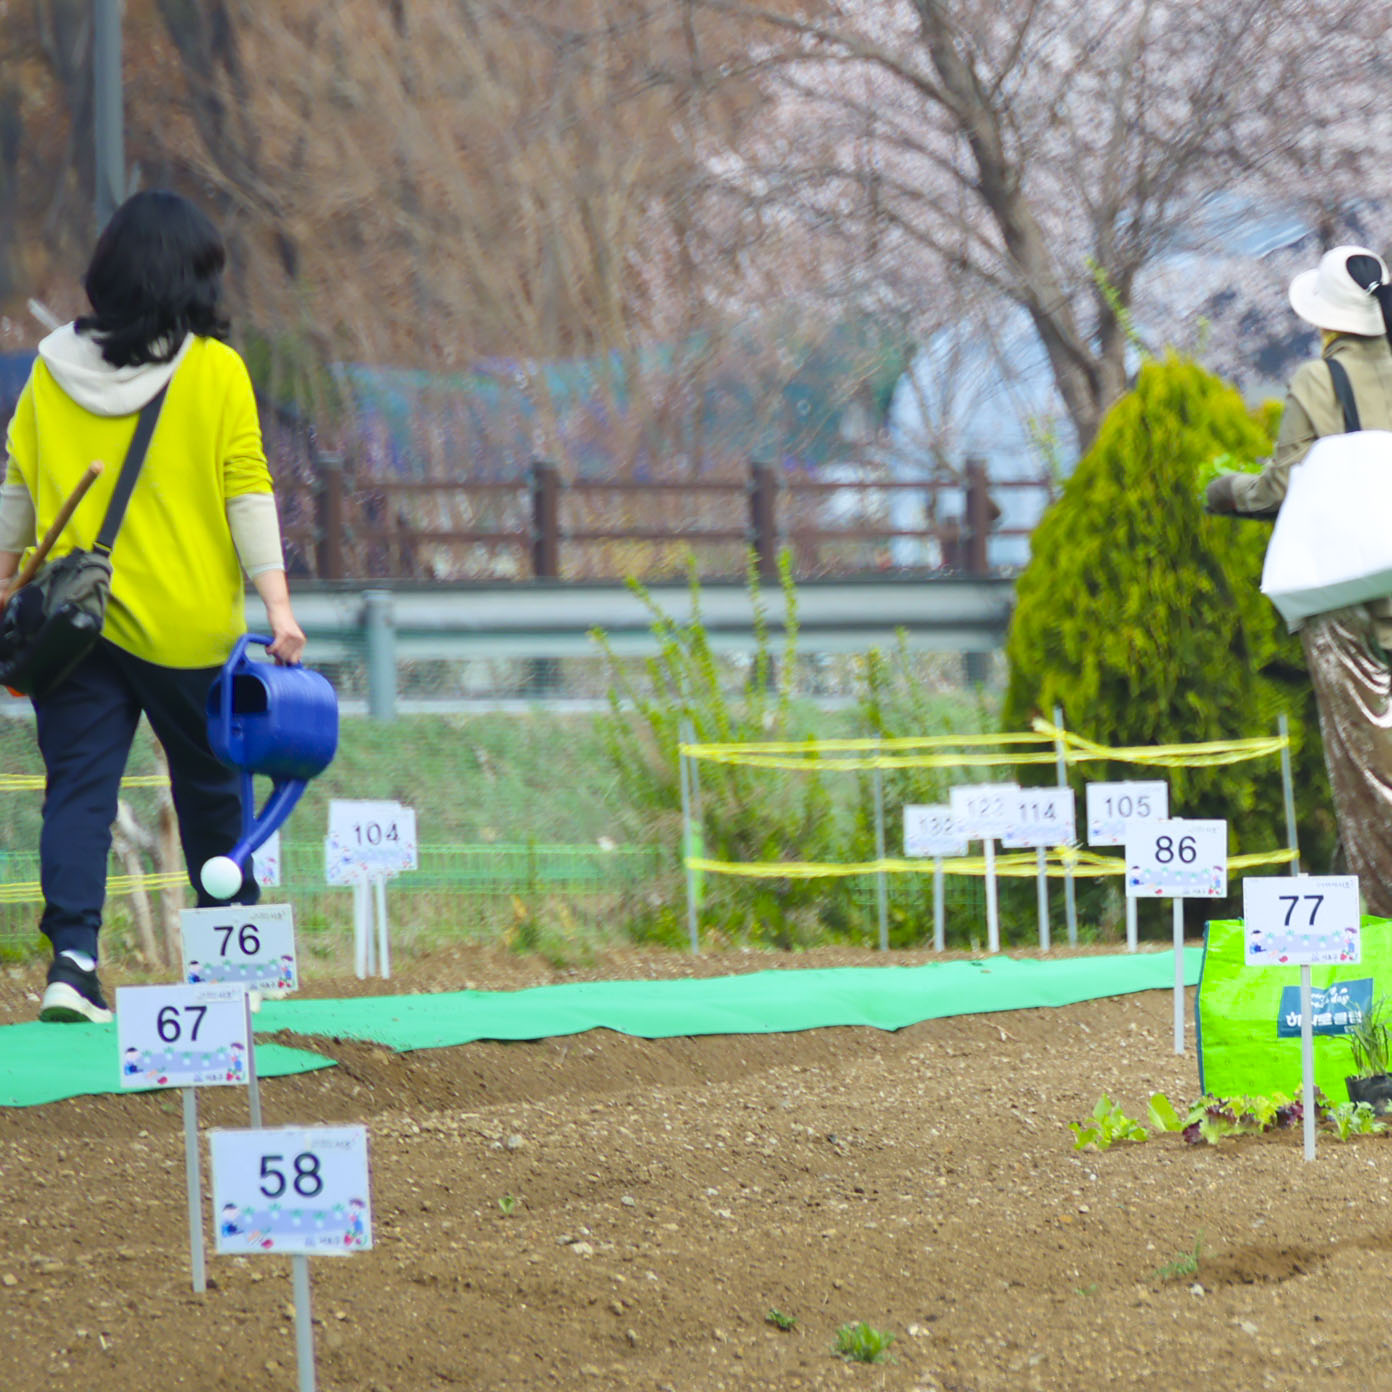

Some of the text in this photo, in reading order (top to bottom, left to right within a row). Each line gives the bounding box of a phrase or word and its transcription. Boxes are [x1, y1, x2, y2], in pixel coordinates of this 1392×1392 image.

[1019, 802, 1057, 822] 114
[1105, 795, 1151, 818] 105
[355, 819, 399, 845] 104
[1155, 835, 1197, 864] 86
[1279, 894, 1325, 927] 77
[213, 924, 261, 956] 76
[156, 1005, 208, 1043] 67
[259, 1151, 324, 1198] 58
